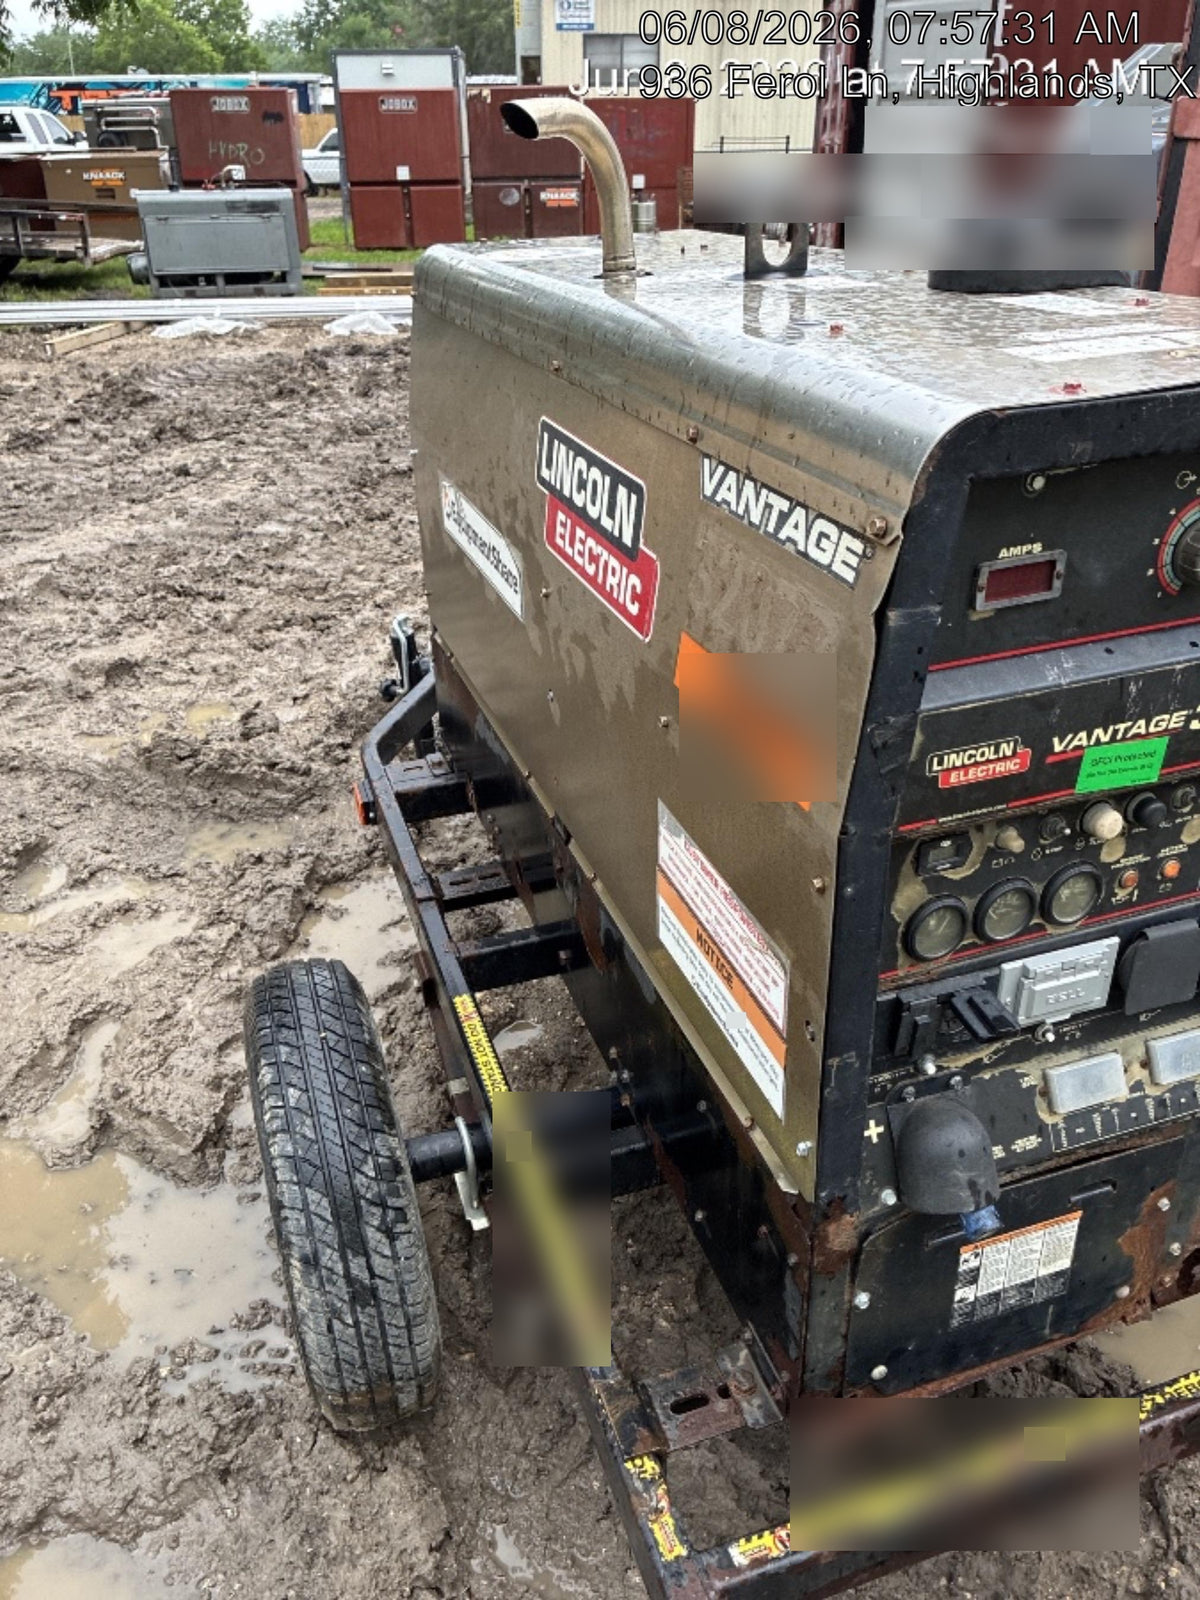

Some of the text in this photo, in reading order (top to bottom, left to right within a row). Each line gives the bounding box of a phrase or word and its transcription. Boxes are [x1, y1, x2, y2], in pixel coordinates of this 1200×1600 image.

[380, 97, 416, 111] JOBOX
[208, 140, 265, 168] HYDRO
[541, 432, 638, 548] LINCOLN
[702, 456, 868, 583] VANTAGE
[554, 509, 642, 616] ELECTRIC
[998, 541, 1043, 559] AMPS
[1051, 709, 1189, 753] VANTAGE
[932, 740, 1015, 771] LINCOLN
[949, 758, 1021, 783] ELECTRIC
[696, 927, 734, 990] NOTICE
[467, 1023, 480, 1037] DO
